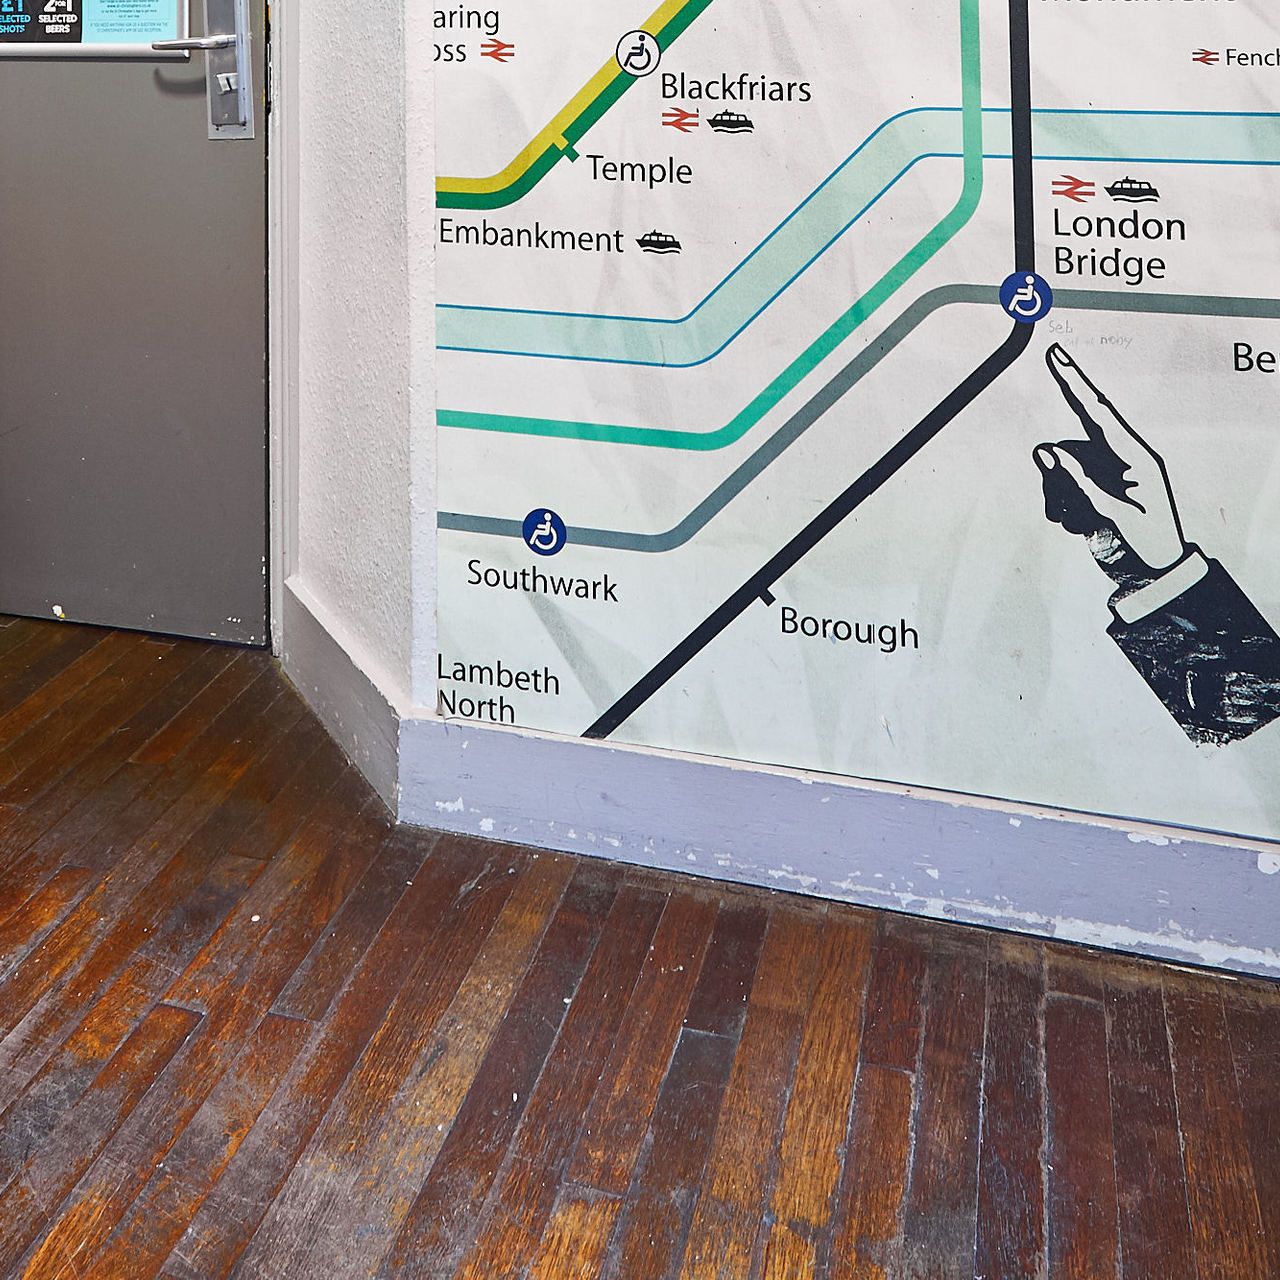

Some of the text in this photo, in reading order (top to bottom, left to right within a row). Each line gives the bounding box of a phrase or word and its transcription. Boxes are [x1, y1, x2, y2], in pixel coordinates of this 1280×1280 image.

[38, 14, 78, 24] SELECTED
[45, 24, 70, 34] BEERS
[661, 71, 812, 102] Blackfriars
[585, 154, 693, 190] Temple
[440, 217, 625, 253] Embankment
[1054, 208, 1186, 241] London
[1055, 246, 1166, 286] Bridge
[467, 559, 619, 603] Southwark
[781, 606, 919, 654] Borough
[437, 653, 560, 696] Lambeth
[437, 689, 516, 725] North
